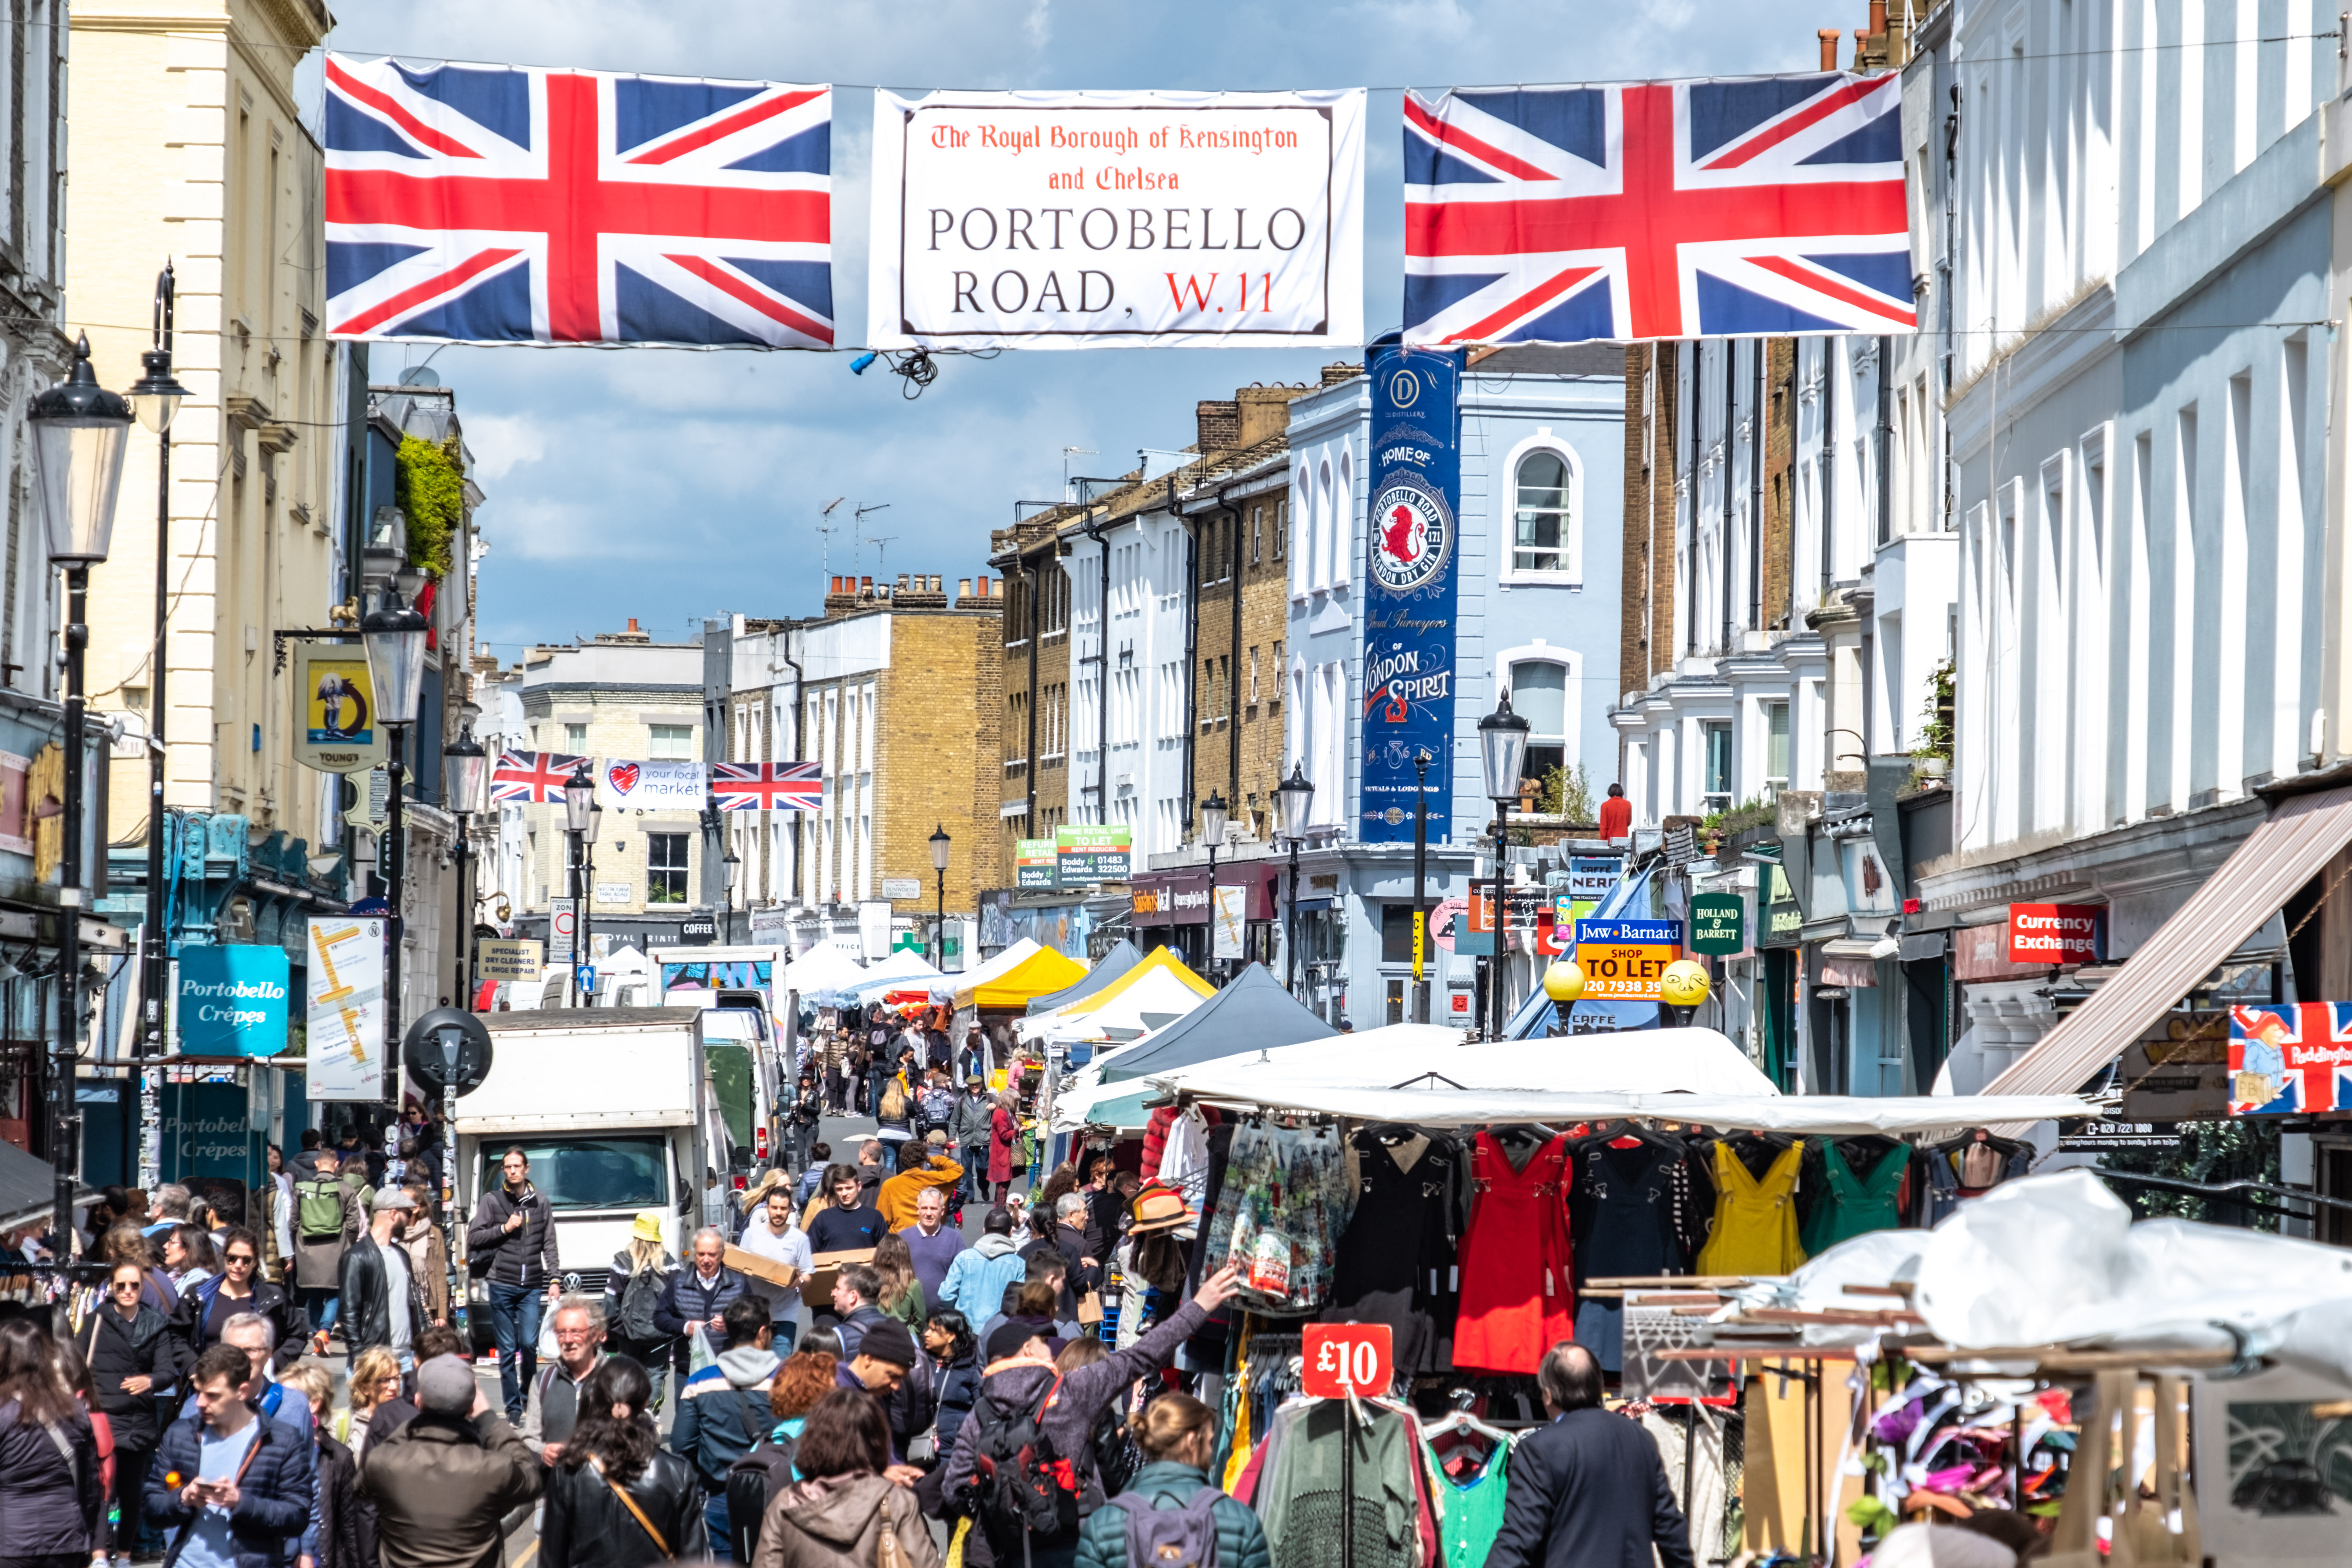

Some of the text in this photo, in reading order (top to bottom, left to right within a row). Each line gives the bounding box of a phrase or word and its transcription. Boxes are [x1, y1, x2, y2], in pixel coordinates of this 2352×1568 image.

[932, 124, 1298, 156] The Royal Borough of Kensington
[1048, 166, 1179, 191] and Chelsea
[927, 207, 1305, 252] PORTOBELLO
[951, 269, 1273, 319] ROAD, W.11
[1397, 378, 1413, 400] D
[1382, 446, 1431, 467] HOME OF
[1376, 490, 1438, 522] PORTOBELLO ROAD
[1428, 531, 1440, 542] 171
[1374, 552, 1437, 584] LONDON DRY GIN
[1366, 609, 1448, 636] Proud Purveyors
[1364, 642, 1420, 693] LONDON
[1388, 670, 1451, 703] SPIRIT
[319, 752, 359, 762] YOUNG'S
[646, 770, 699, 779] your local
[369, 770, 388, 821] LEATHER
[644, 782, 700, 795] market
[1075, 836, 1112, 845] TO LET
[1433, 908, 1444, 920] JOE
[1697, 909, 1738, 920] HOLLAND
[683, 924, 713, 934] COFFEE
[1621, 924, 1679, 939] Barnard
[1713, 918, 1722, 929] &
[2017, 915, 2093, 932] Currency
[1697, 929, 1737, 940] BARRETT
[2014, 935, 2095, 953] Exchange
[1612, 949, 1643, 959] SHOP
[1587, 959, 1667, 977] TO LET
[180, 980, 285, 999] Portobello
[1609, 981, 1642, 992] 7938
[198, 1005, 266, 1026] Crêpes
[1573, 1014, 1615, 1024] CAFFÈ
[2292, 1045, 2352, 1066] Paddingto
[2240, 1081, 2257, 1097] PB
[164, 1117, 246, 1133] Portobel
[2100, 1124, 2116, 1133] 020
[181, 1141, 247, 1161] Crêpes
[1316, 1341, 1377, 1385] £10
